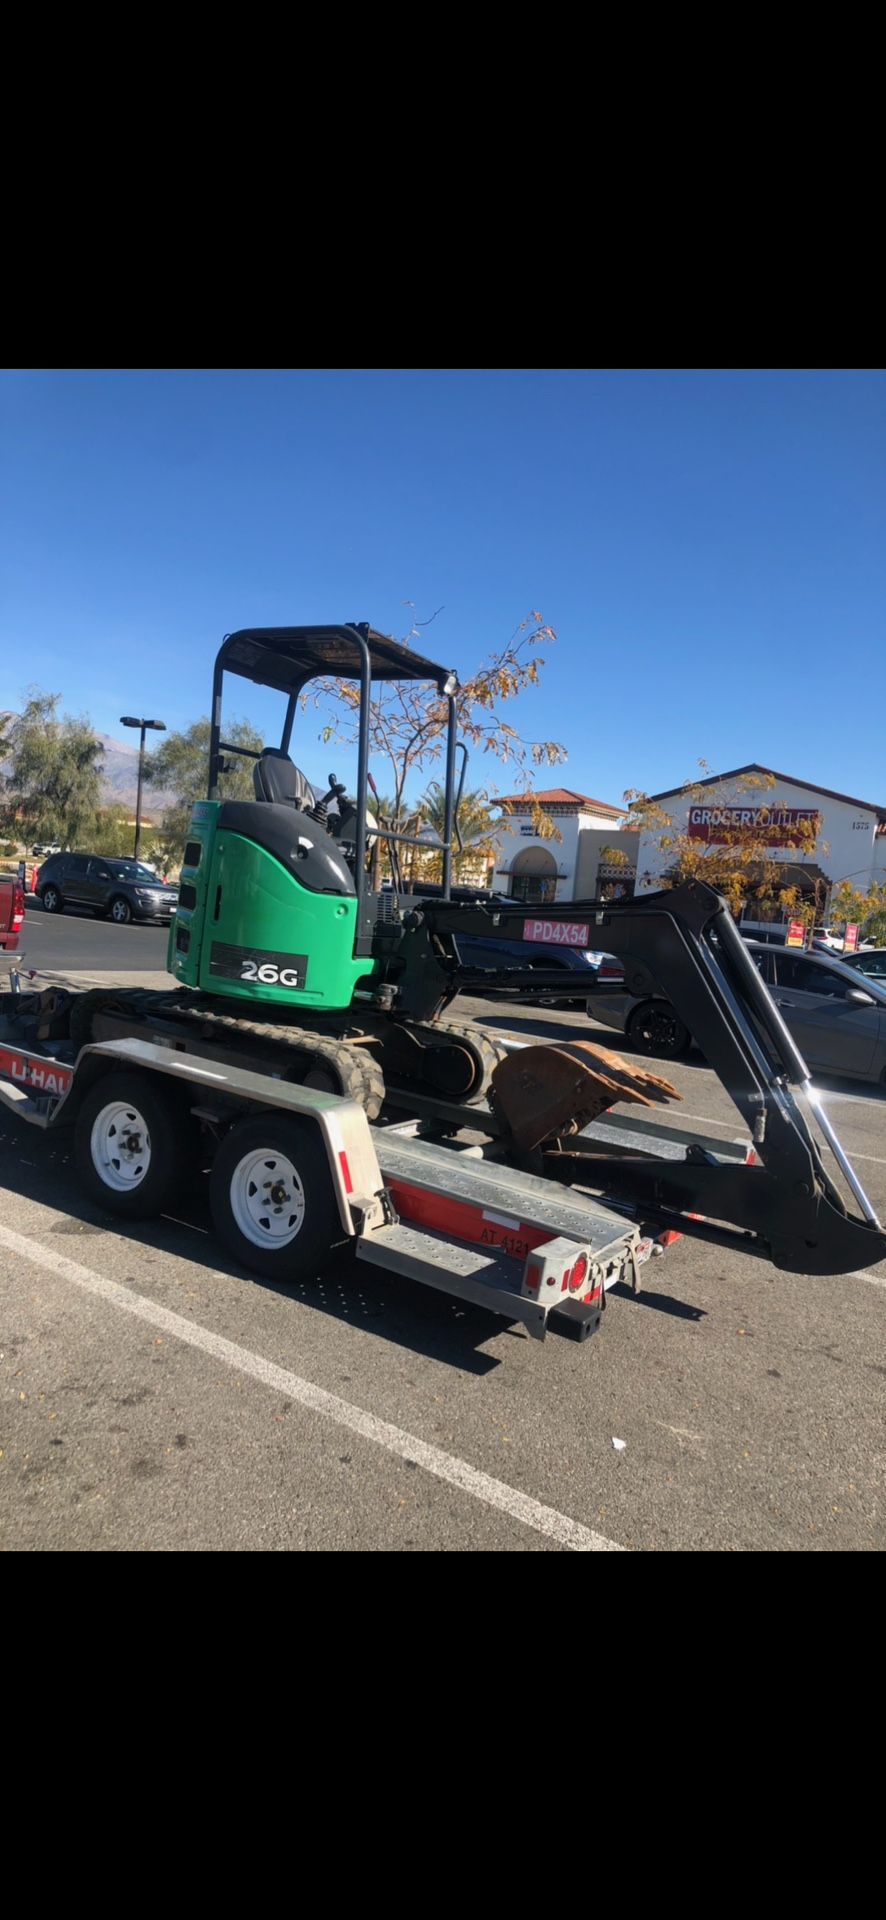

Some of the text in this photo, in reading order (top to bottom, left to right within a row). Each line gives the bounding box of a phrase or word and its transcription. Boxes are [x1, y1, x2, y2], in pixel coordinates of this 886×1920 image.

[852, 821, 870, 831] 1575
[532, 921, 588, 944] PD4X54
[240, 960, 298, 987] 26G
[480, 1228, 498, 1245] AT
